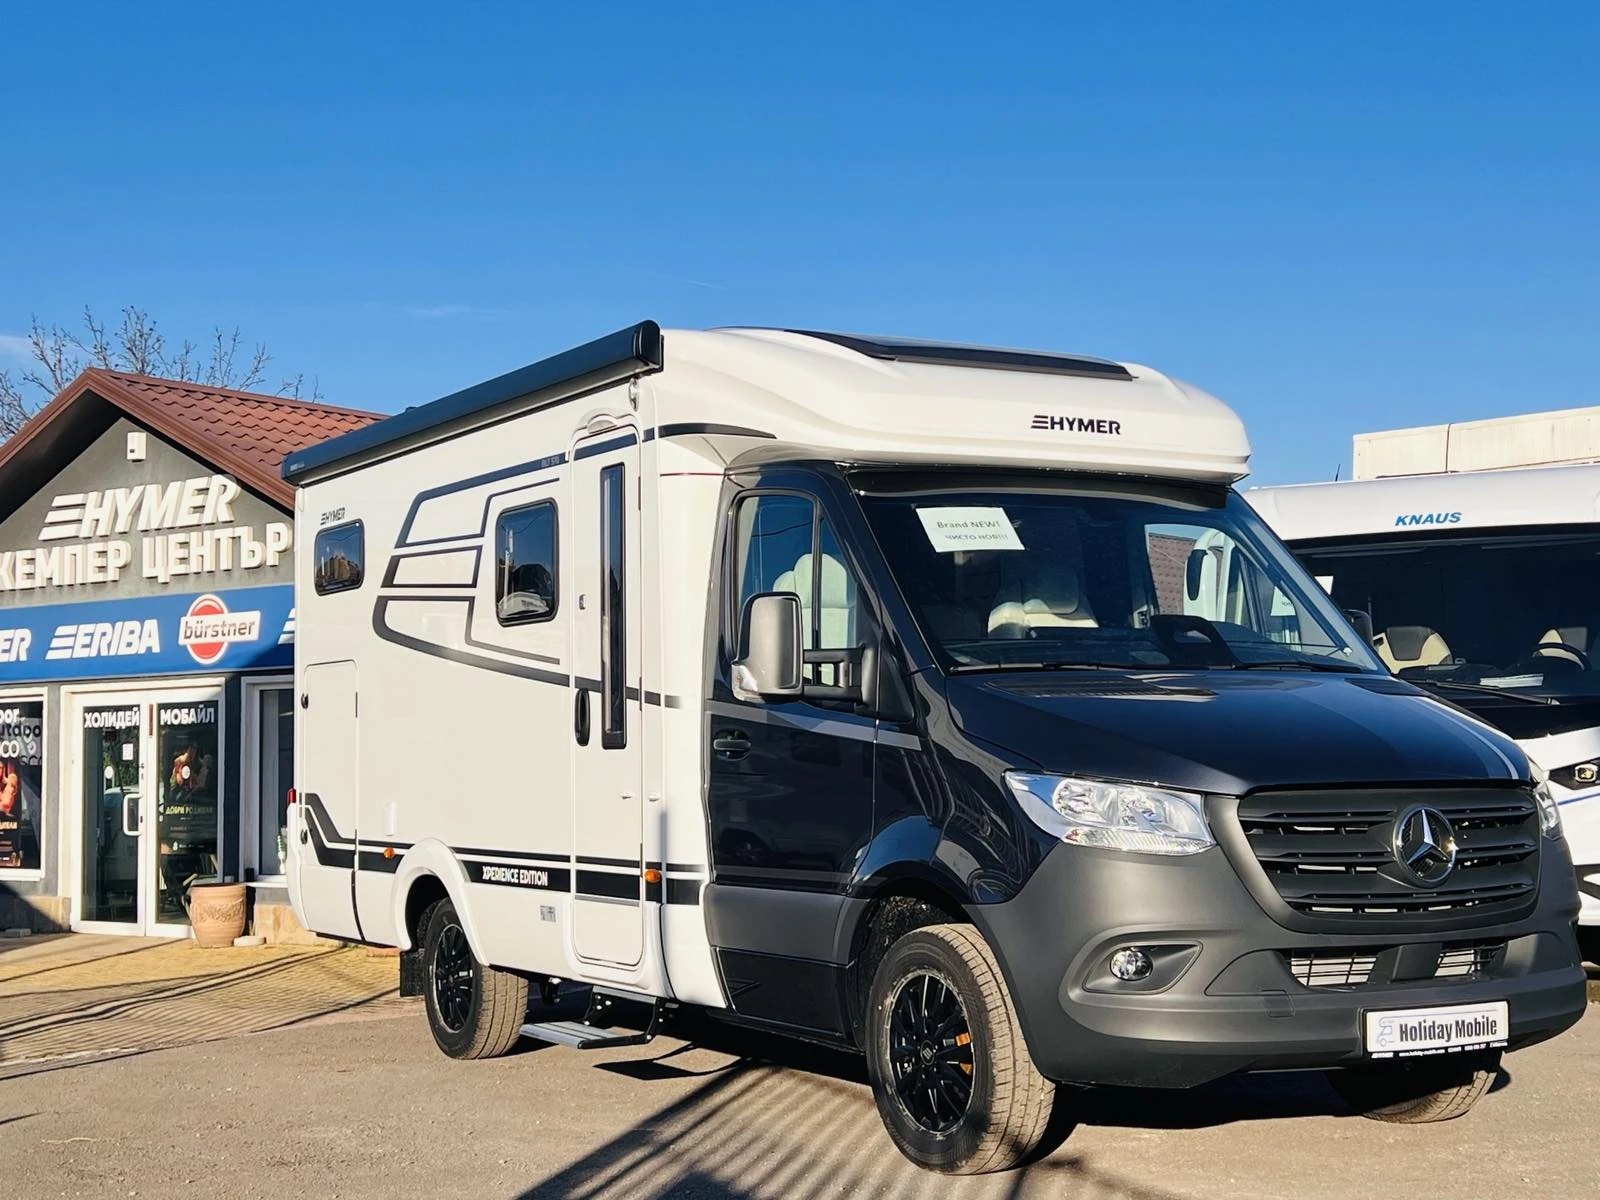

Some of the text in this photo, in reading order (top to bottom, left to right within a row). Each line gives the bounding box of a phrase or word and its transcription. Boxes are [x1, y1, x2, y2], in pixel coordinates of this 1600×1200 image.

[1050, 415, 1121, 435] HYMER
[79, 474, 241, 538] HYMER
[324, 507, 346, 525] HYMER
[970, 520, 1001, 528] NEW!
[1395, 512, 1462, 526] KNAUS
[0, 522, 292, 591] КЕМПЕР ЦЕНТЪР
[72, 619, 160, 658] ERIBA
[183, 620, 256, 640] bürstner
[84, 704, 215, 730] ХОЛИДЕЙ МОБАЙЛ
[482, 866, 548, 887] XPERIENCE EDITION
[1400, 1014, 1497, 1043] Holiday Mobile
